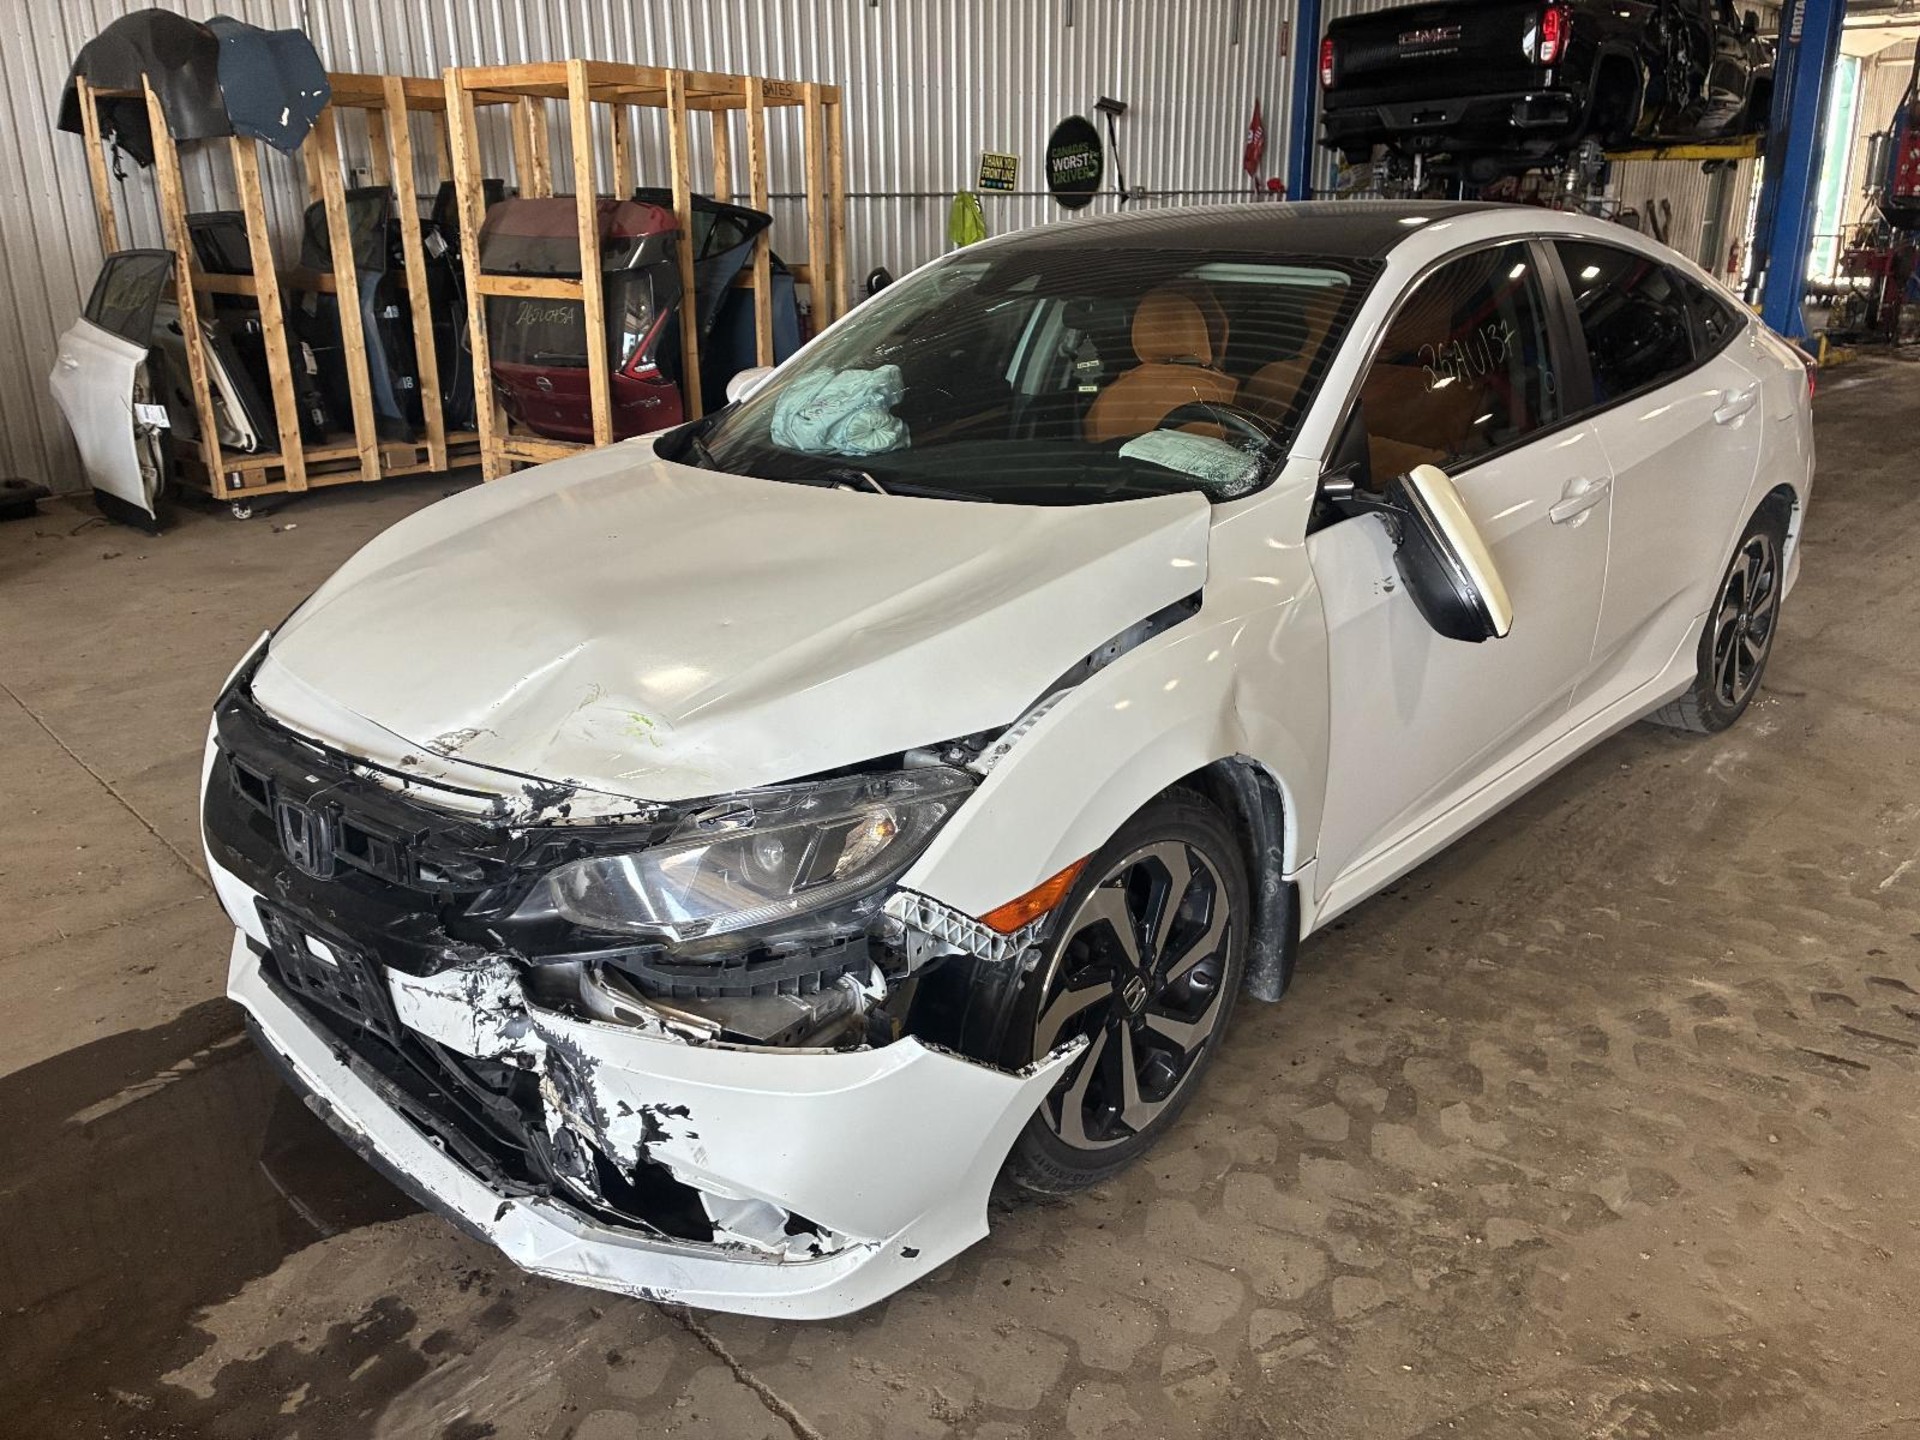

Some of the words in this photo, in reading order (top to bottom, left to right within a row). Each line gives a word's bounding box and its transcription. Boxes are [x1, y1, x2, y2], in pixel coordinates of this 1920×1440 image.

[984, 154, 1003, 169] THANK
[1003, 157, 1016, 170] YOU
[1052, 152, 1089, 172] WORST
[981, 166, 1002, 180] FRONT
[1001, 169, 1015, 182] LINE
